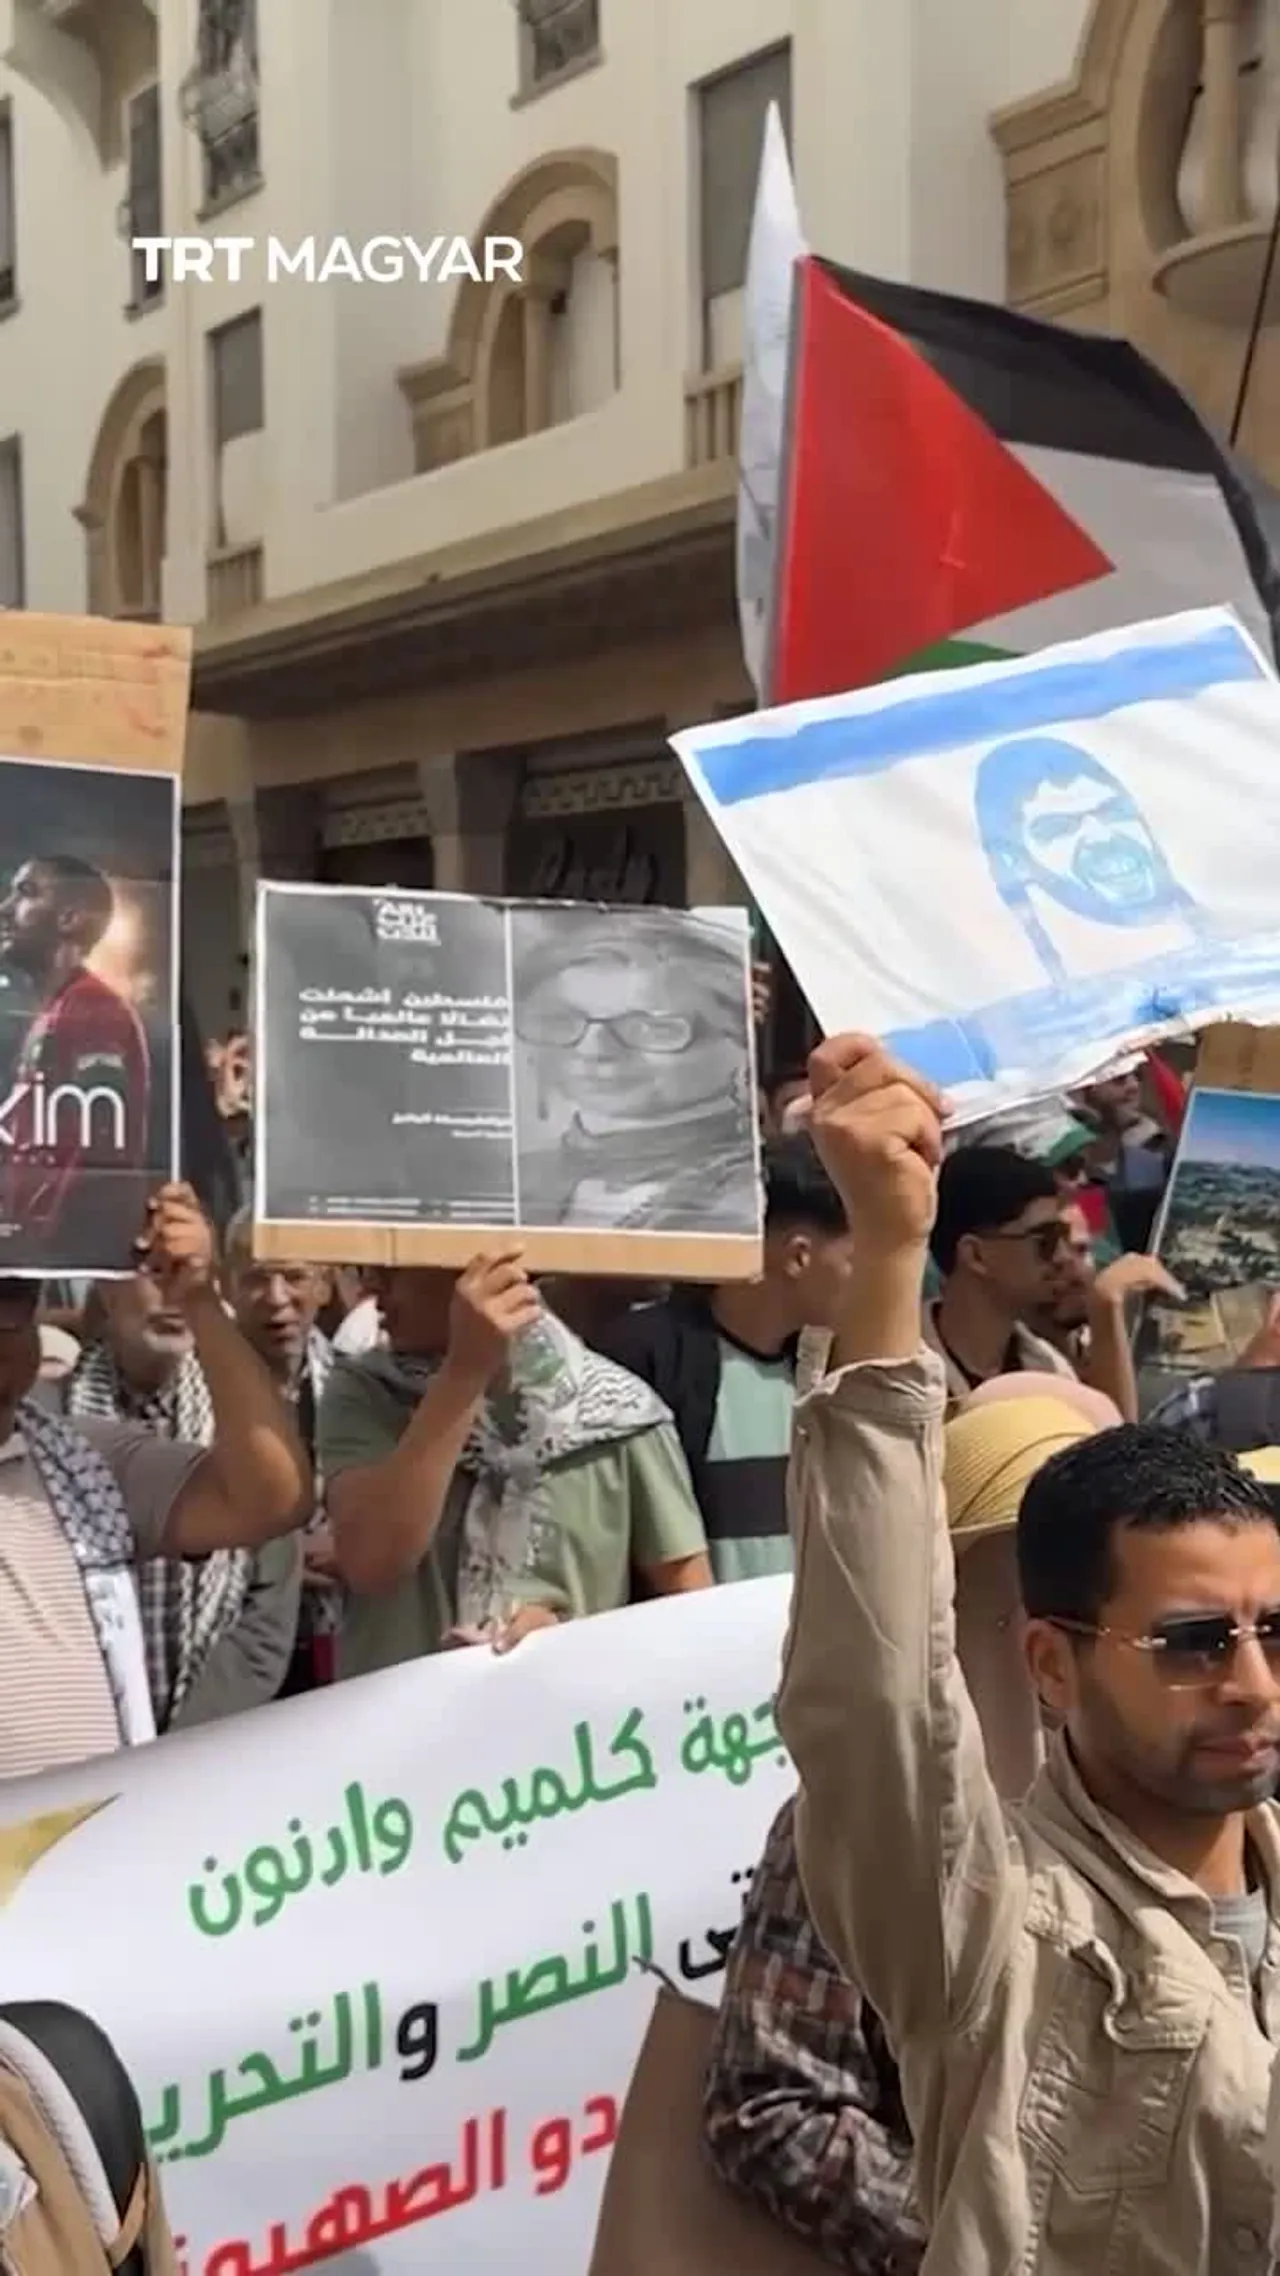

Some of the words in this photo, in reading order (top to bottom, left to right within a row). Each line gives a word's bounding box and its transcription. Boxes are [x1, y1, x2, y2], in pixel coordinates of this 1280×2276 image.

[443, 1708, 658, 1864] كلميم
[457, 1892, 654, 2063] النصر
[143, 1980, 438, 2164] والتحري
